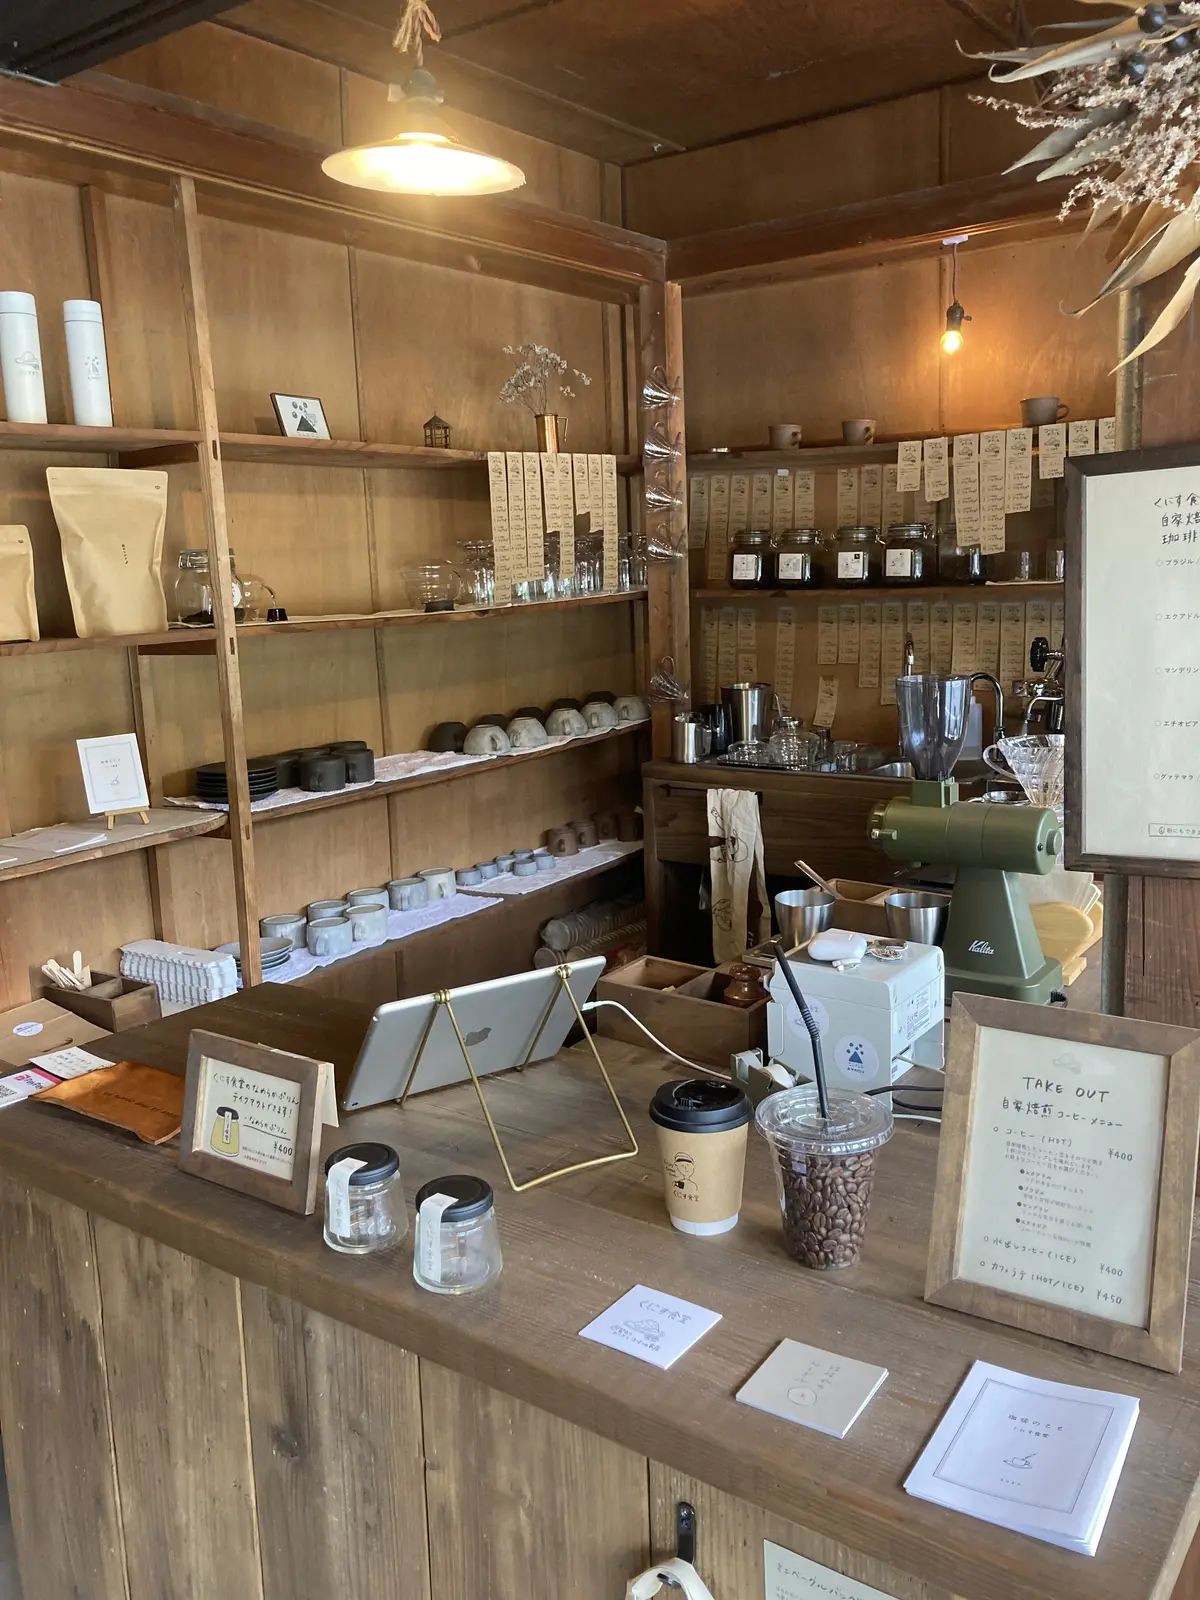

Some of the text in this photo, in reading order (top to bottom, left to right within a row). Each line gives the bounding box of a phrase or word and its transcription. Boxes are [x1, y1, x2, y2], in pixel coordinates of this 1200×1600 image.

[968, 939, 995, 955] Kalita
[1022, 1076, 1110, 1103] TAKE OUT
[273, 1140, 294, 1157] ¥400
[1108, 1148, 1133, 1162] ¥400
[1100, 1262, 1124, 1277] ¥400
[1096, 1289, 1123, 1305] ¥450
